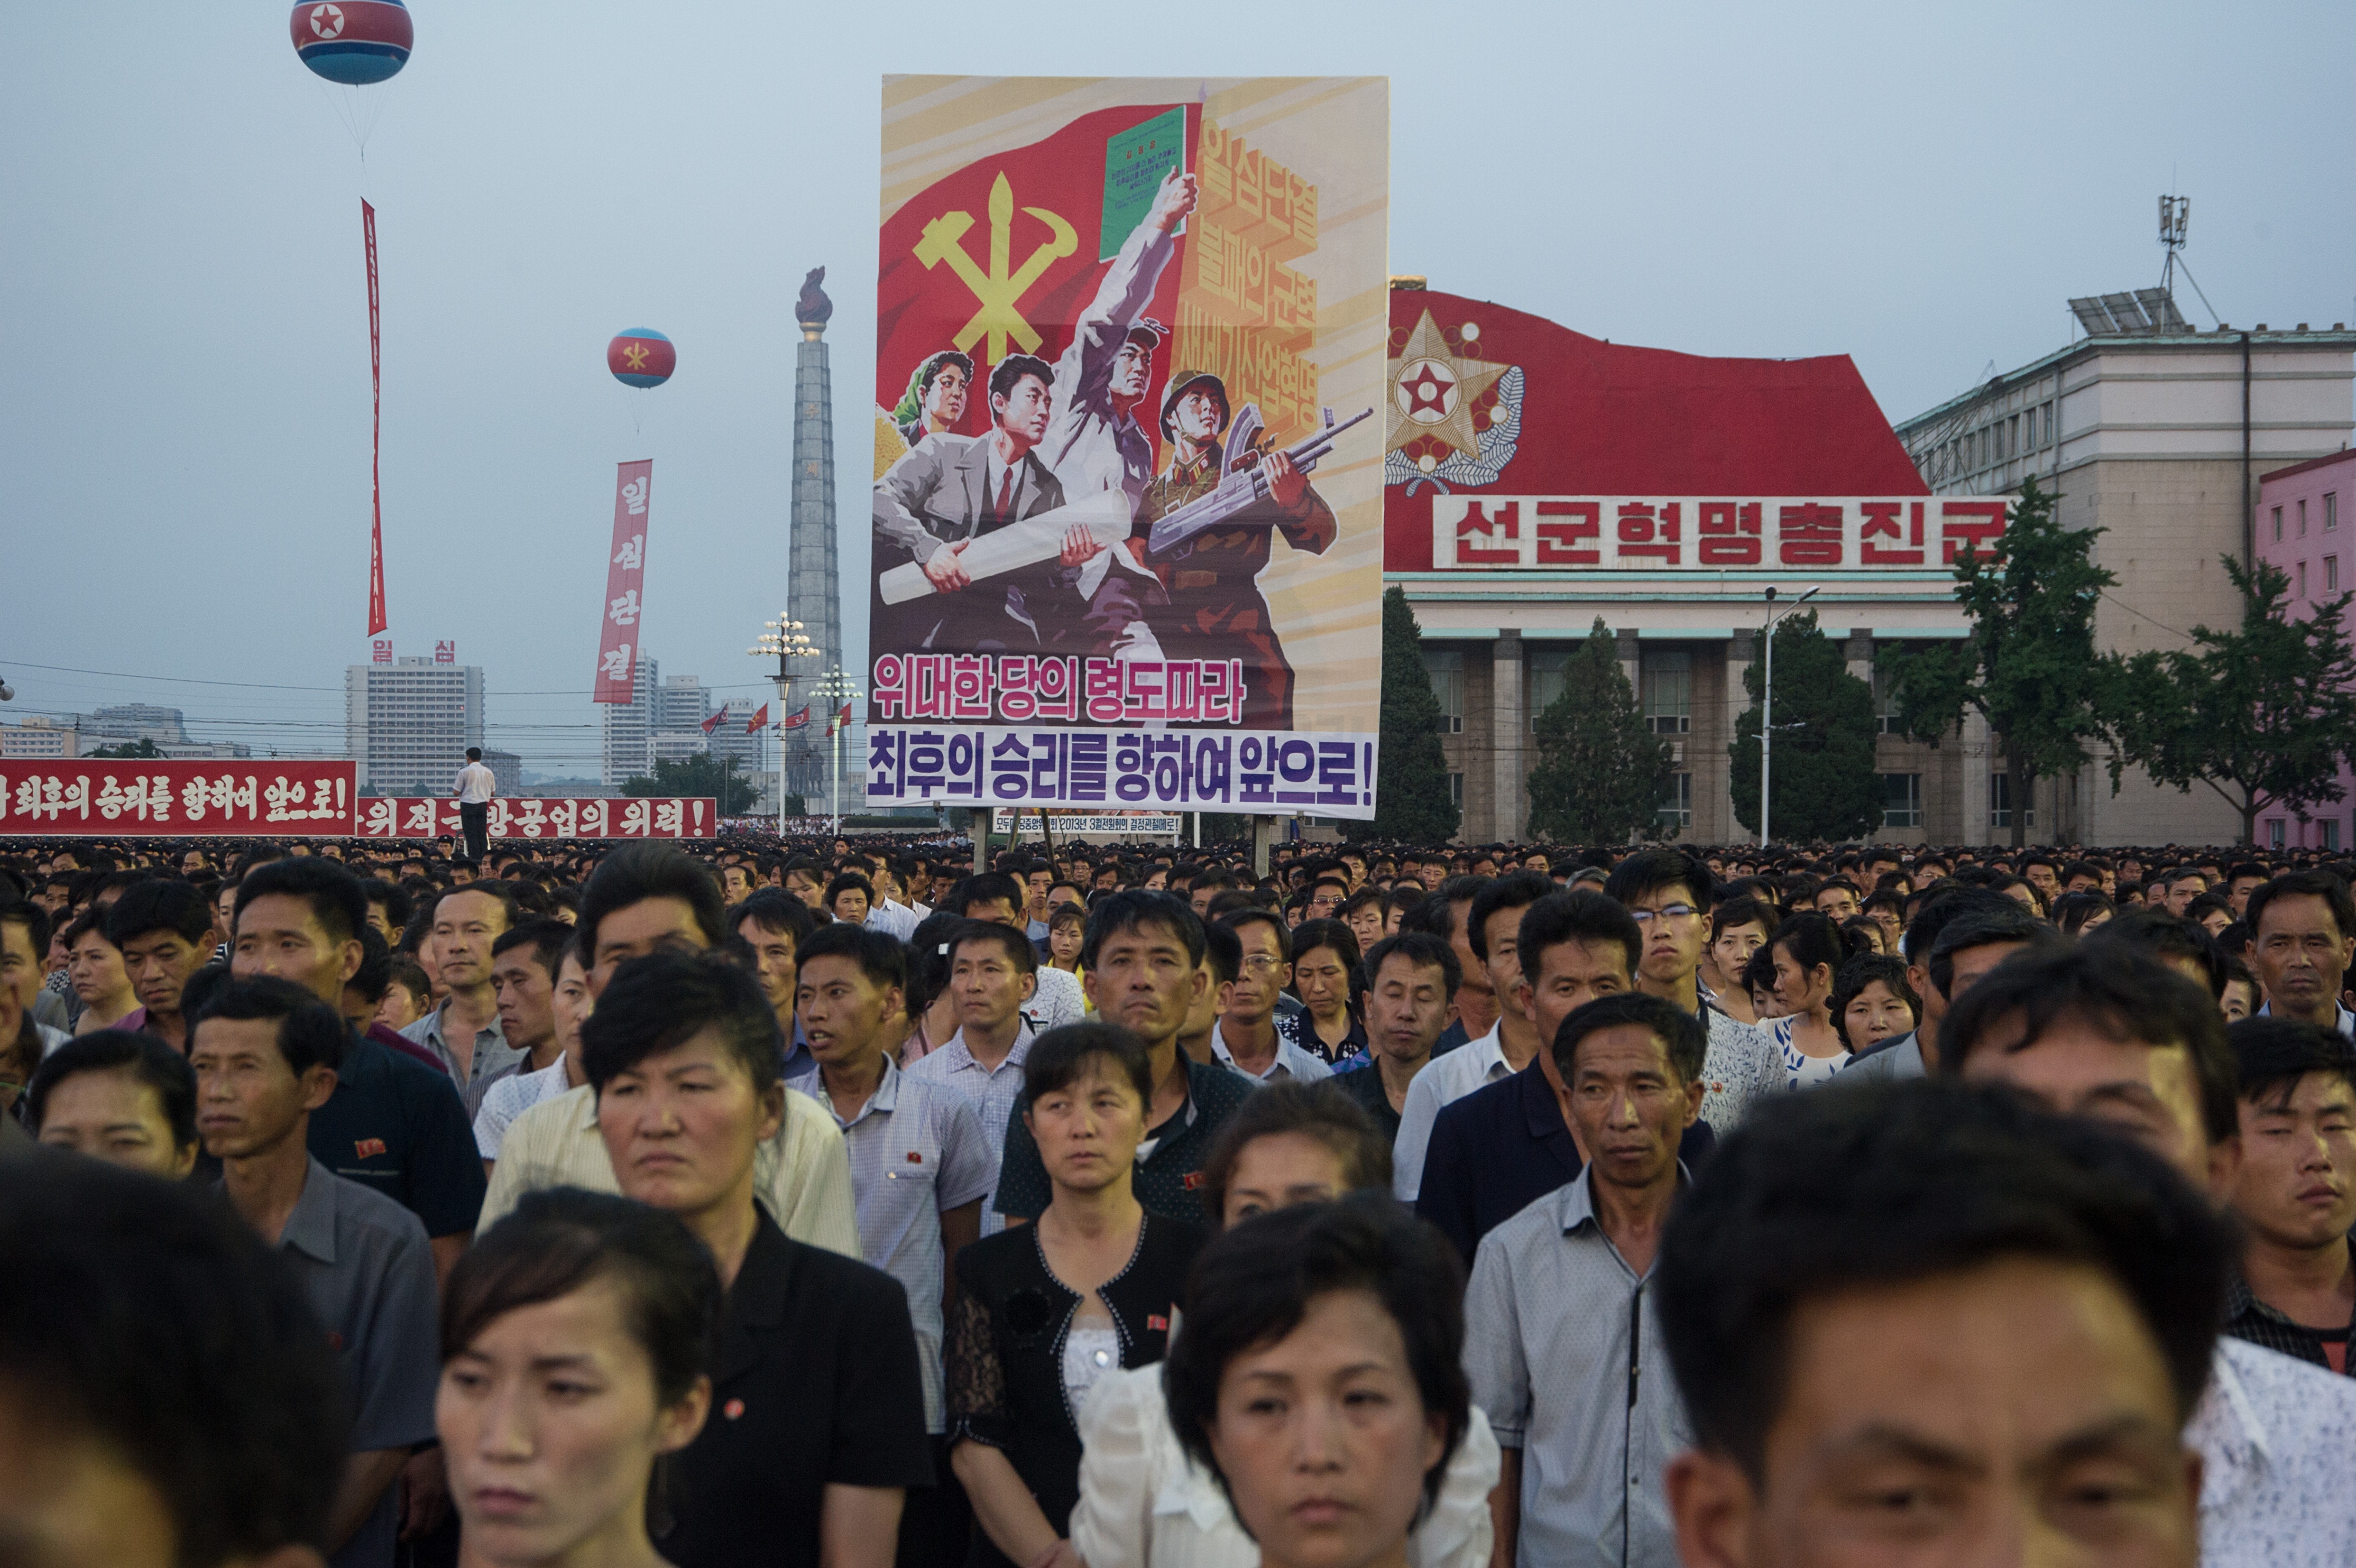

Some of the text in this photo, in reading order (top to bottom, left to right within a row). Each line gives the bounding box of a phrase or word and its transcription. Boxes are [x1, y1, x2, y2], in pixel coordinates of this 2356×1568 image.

[1203, 118, 1318, 250] 일심단결
[1456, 501, 2006, 564] 선군혁명총진군
[599, 476, 647, 681] 일심단결
[874, 654, 1246, 723] 위대한 당의 령도따라
[14, 775, 90, 821] 최후의
[95, 775, 174, 821] 승리를
[181, 774, 257, 821] 향하여
[264, 776, 346, 822] 앞으로!
[868, 730, 1372, 806] 최후의 승리를 향하여 앞으로!
[620, 799, 704, 838] 위력!
[1018, 818, 1057, 831] 당중앙위회
[1060, 818, 1087, 831] 2013년
[1090, 818, 1128, 831] 3월전원회의
[1130, 818, 1179, 831] 결정관철에로!
